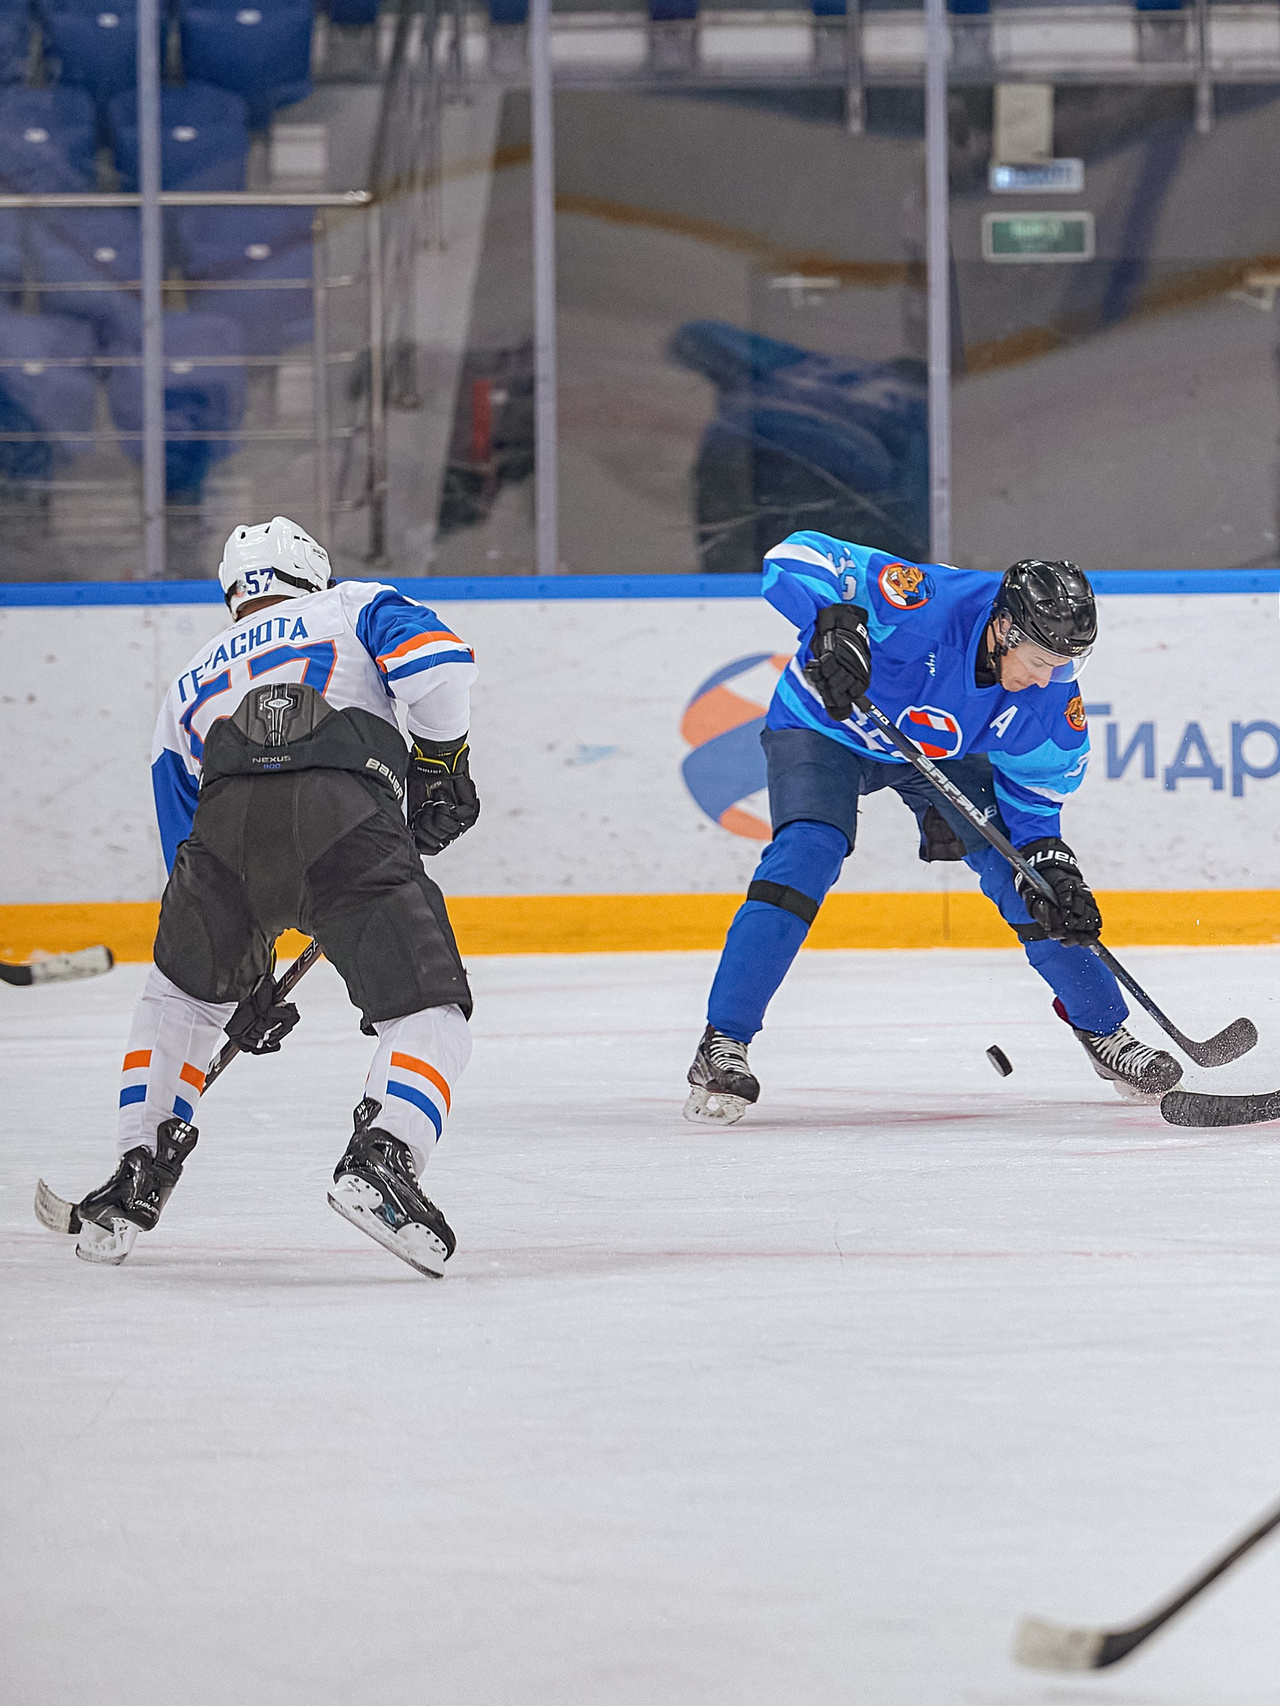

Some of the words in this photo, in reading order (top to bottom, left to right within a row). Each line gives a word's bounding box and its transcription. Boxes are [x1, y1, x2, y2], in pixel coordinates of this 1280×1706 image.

[244, 567, 275, 596] 57
[988, 704, 1019, 739] A
[252, 754, 292, 764] NEXUS
[364, 756, 405, 801] BAUER
